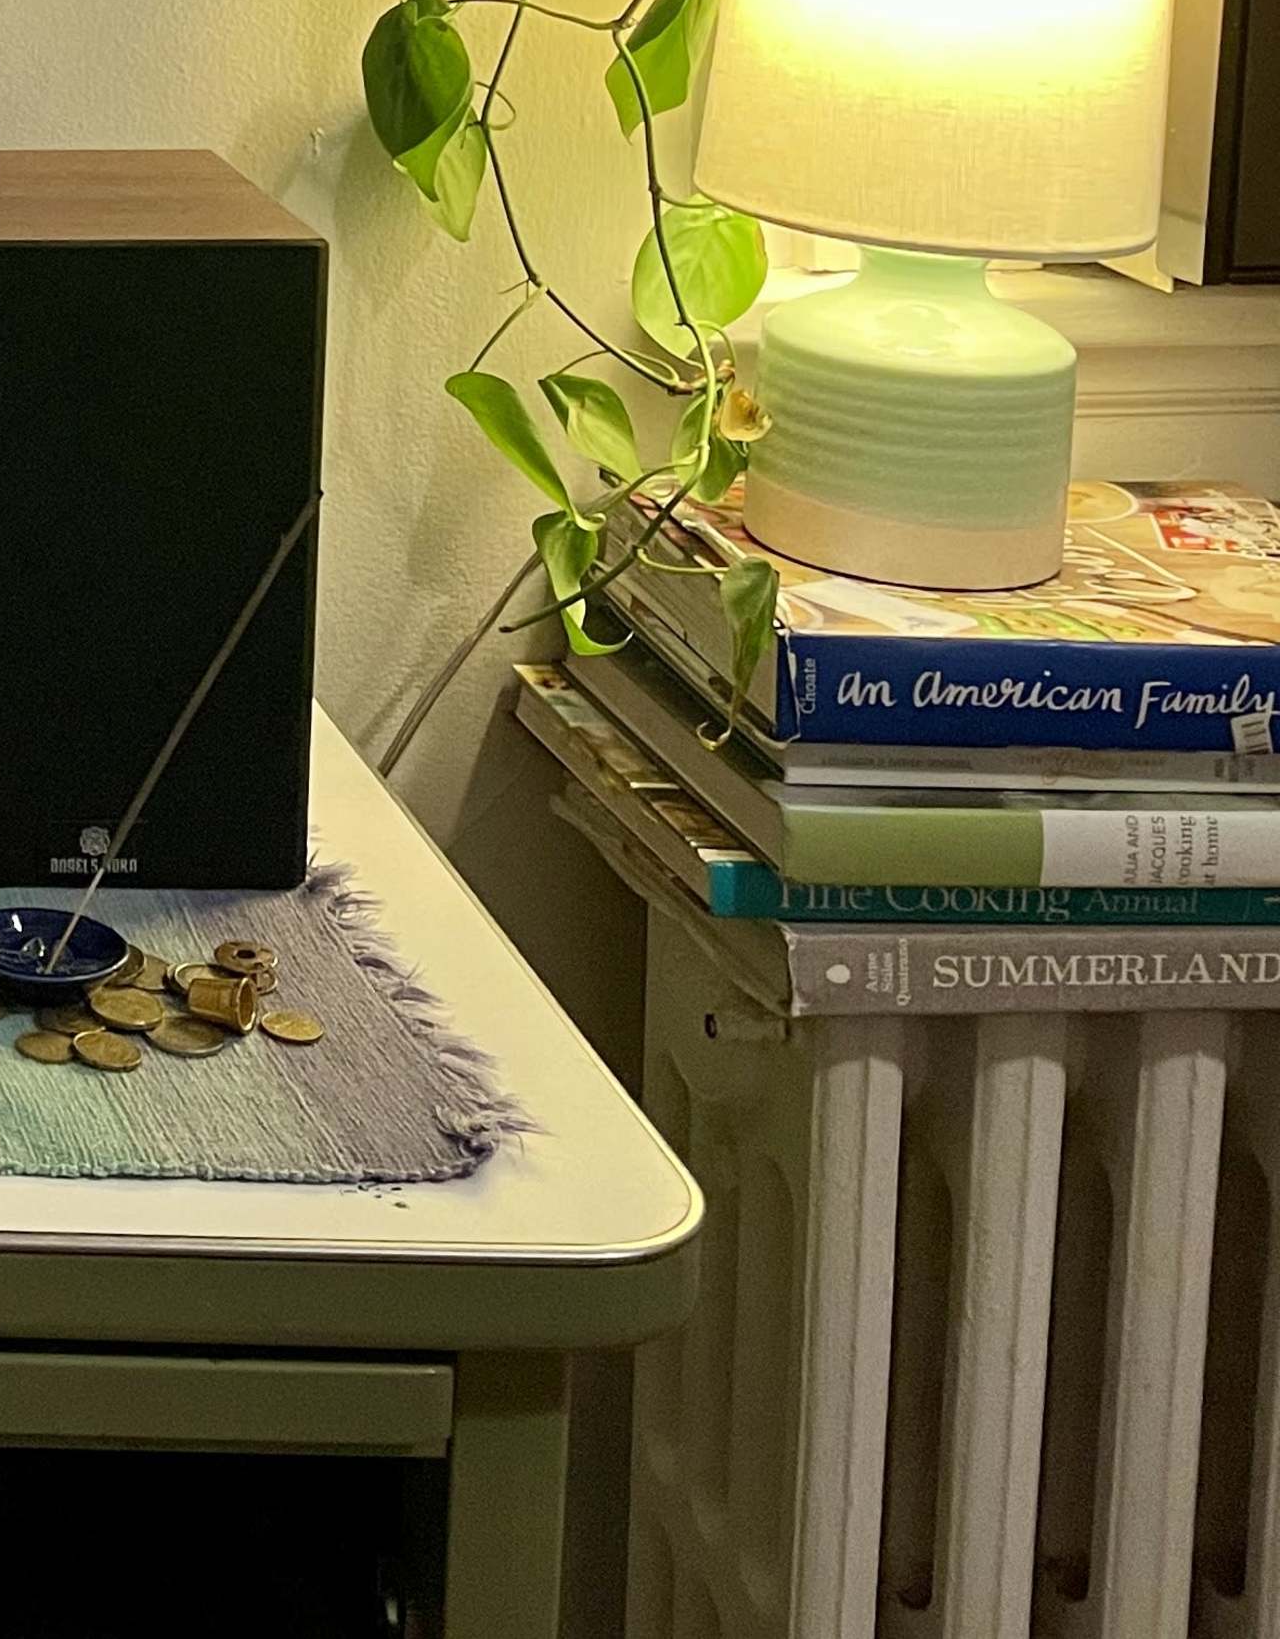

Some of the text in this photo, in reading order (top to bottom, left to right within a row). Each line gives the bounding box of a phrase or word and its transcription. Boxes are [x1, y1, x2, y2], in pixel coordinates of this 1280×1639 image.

[800, 657, 816, 715] Choate
[1134, 673, 1280, 730] Family
[1125, 815, 1139, 848] AND
[1150, 815, 1166, 884] JACQUES
[1201, 815, 1218, 866] home
[885, 885, 1071, 923] Cooking
[1083, 889, 1199, 913] Annual
[933, 954, 1280, 988] SUMMERLAND
